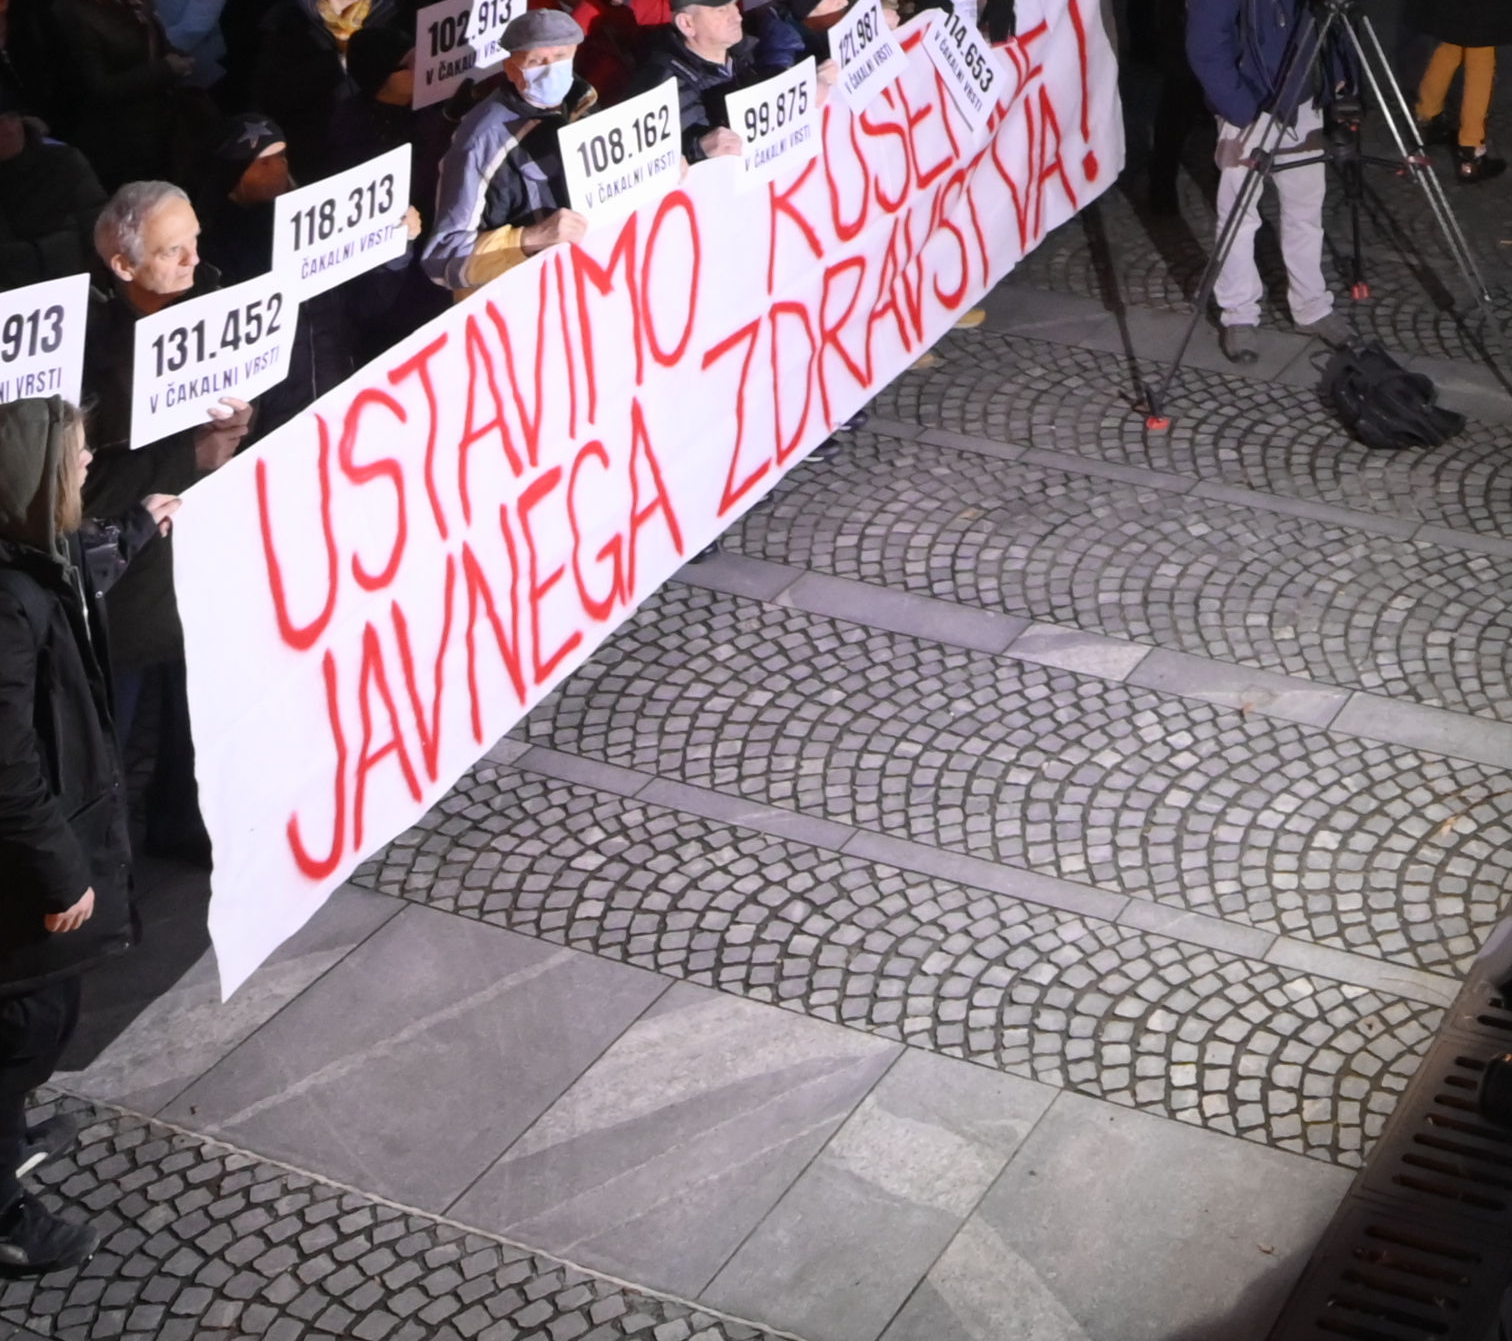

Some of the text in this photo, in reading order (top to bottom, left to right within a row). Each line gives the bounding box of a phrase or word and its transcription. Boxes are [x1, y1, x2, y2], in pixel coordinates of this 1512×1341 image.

[839, 6, 880, 68] 121.987
[744, 81, 808, 143] 99.875
[577, 113, 671, 178] 108.162
[290, 174, 394, 252] 118.313
[598, 169, 644, 204] ČAKALNI
[300, 223, 394, 280] ČAKALNI VRSTI
[152, 292, 283, 378] 131.452
[15, 366, 62, 401] VRSTI
[165, 365, 238, 409] ČAKALNI
[245, 344, 280, 379] VRSTI
[256, 192, 702, 651] USTAVIMO
[287, 397, 685, 882] JAVNEGA
